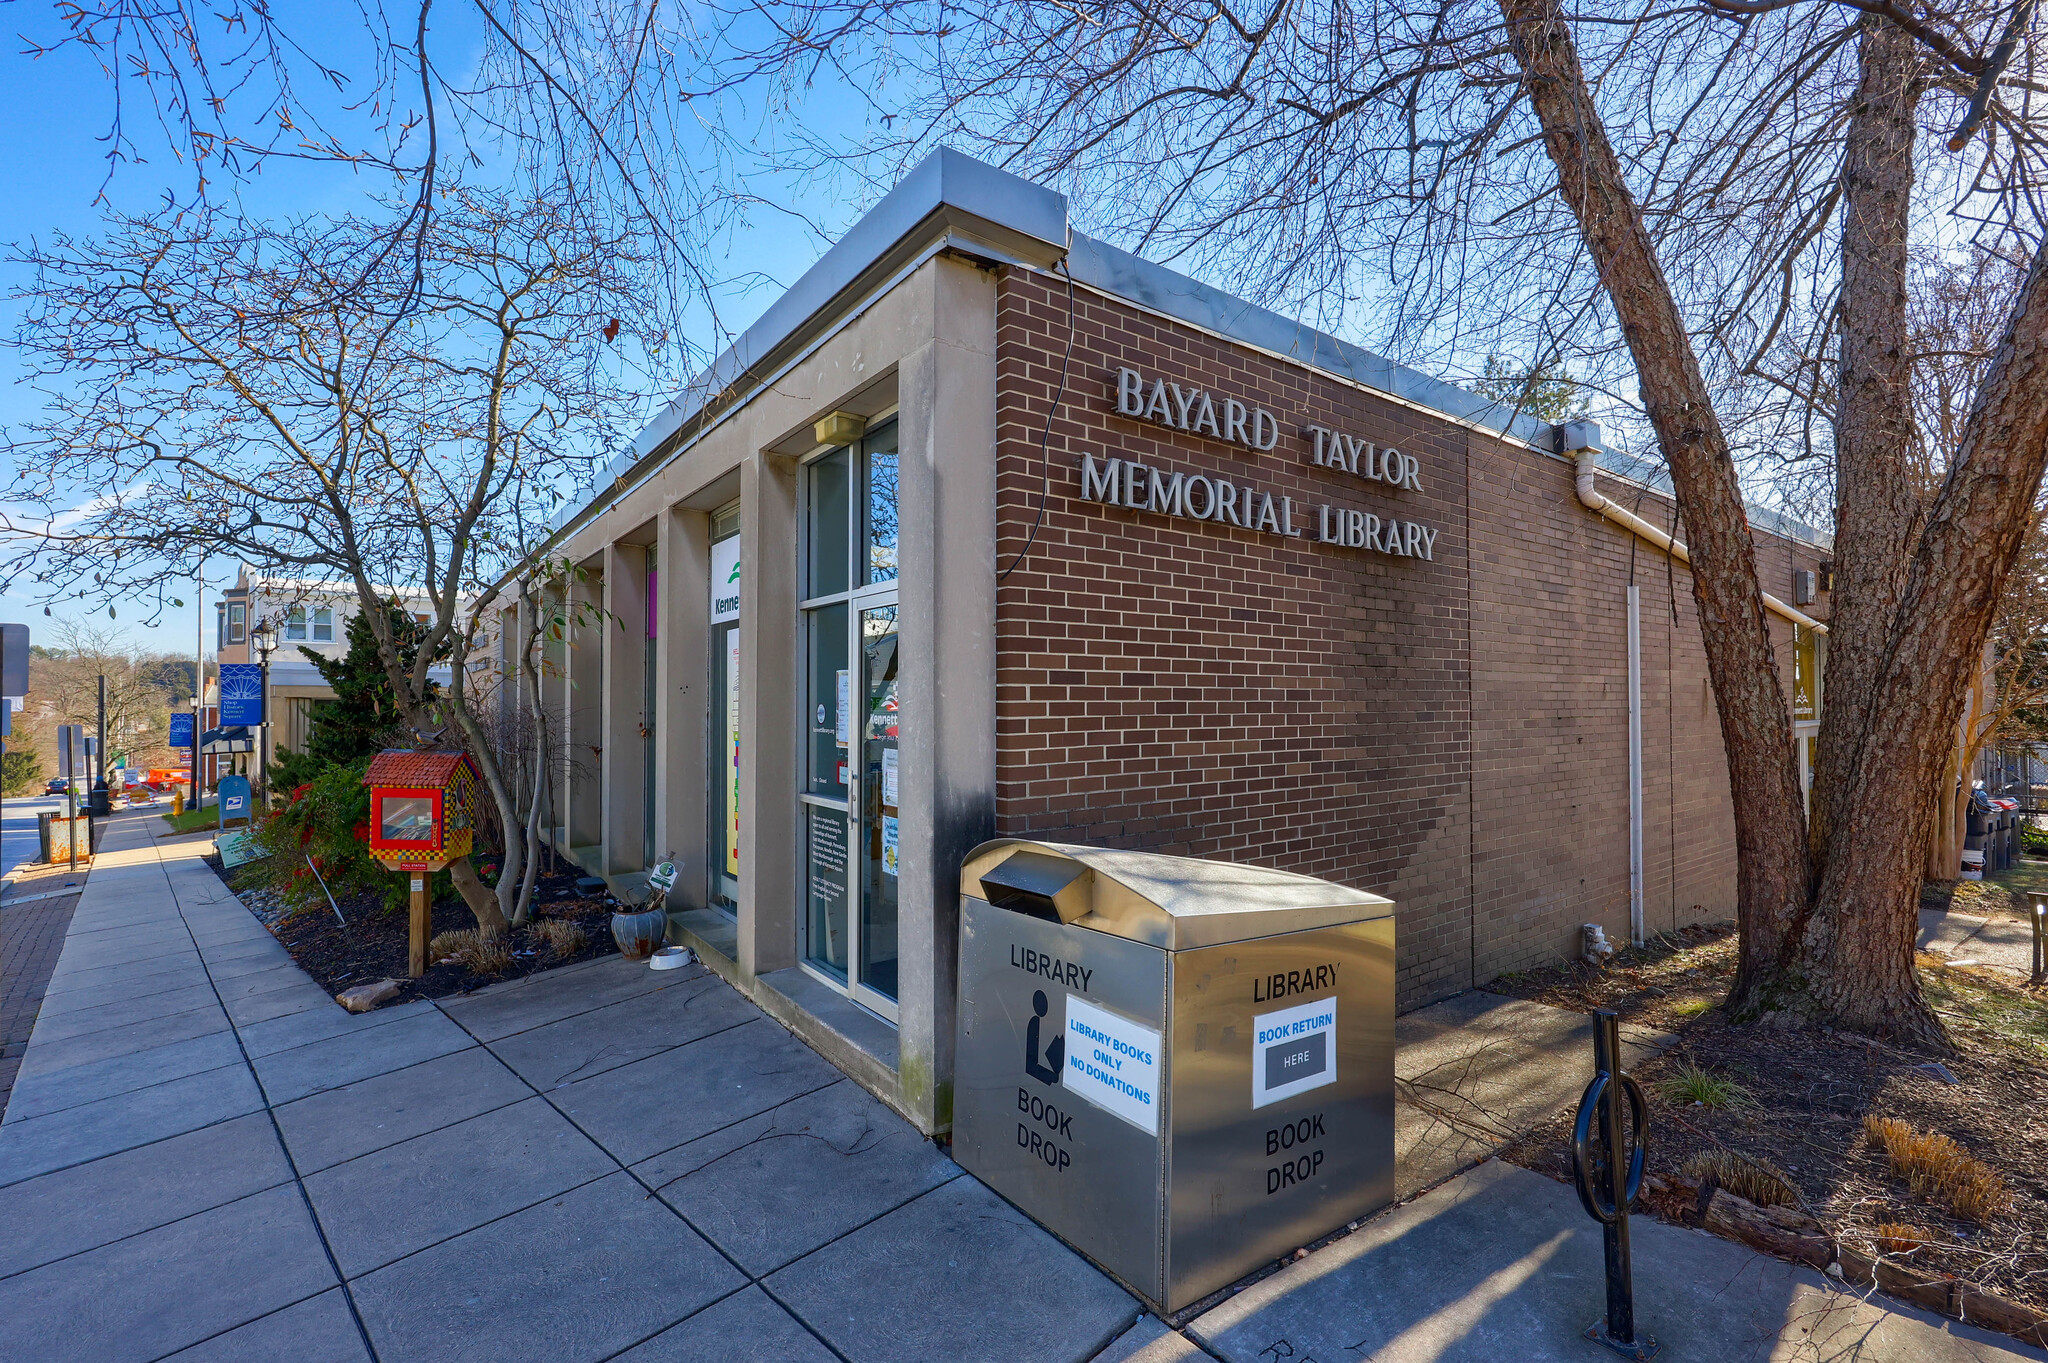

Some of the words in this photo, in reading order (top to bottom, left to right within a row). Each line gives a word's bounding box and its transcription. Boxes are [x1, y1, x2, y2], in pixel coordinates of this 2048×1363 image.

[1116, 365, 1279, 451] BAYARD
[1306, 424, 1424, 492] TAYLOR
[1079, 451, 1301, 538] MEMORIAL
[1319, 504, 1439, 561] LIBRARY
[715, 595, 739, 615] Kenne
[869, 713, 898, 725] Kennett
[1011, 943, 1093, 993] LIBRARY
[1254, 961, 1341, 1003] LIBRARY
[1070, 1018, 1111, 1047] LIBRARY
[1113, 1038, 1152, 1066] BOOKS
[1259, 1024, 1290, 1044] BOOK
[1292, 1012, 1332, 1035] RETURN
[1070, 1055, 1085, 1072] NO
[1086, 1063, 1150, 1105] DONATIONS
[1093, 1049, 1122, 1071] ONLY
[1284, 1050, 1310, 1069] HERE
[1018, 1087, 1073, 1142] BOOK
[1266, 1113, 1326, 1157] BOOK
[1017, 1122, 1071, 1173] DROP
[1267, 1149, 1324, 1196] DROP
